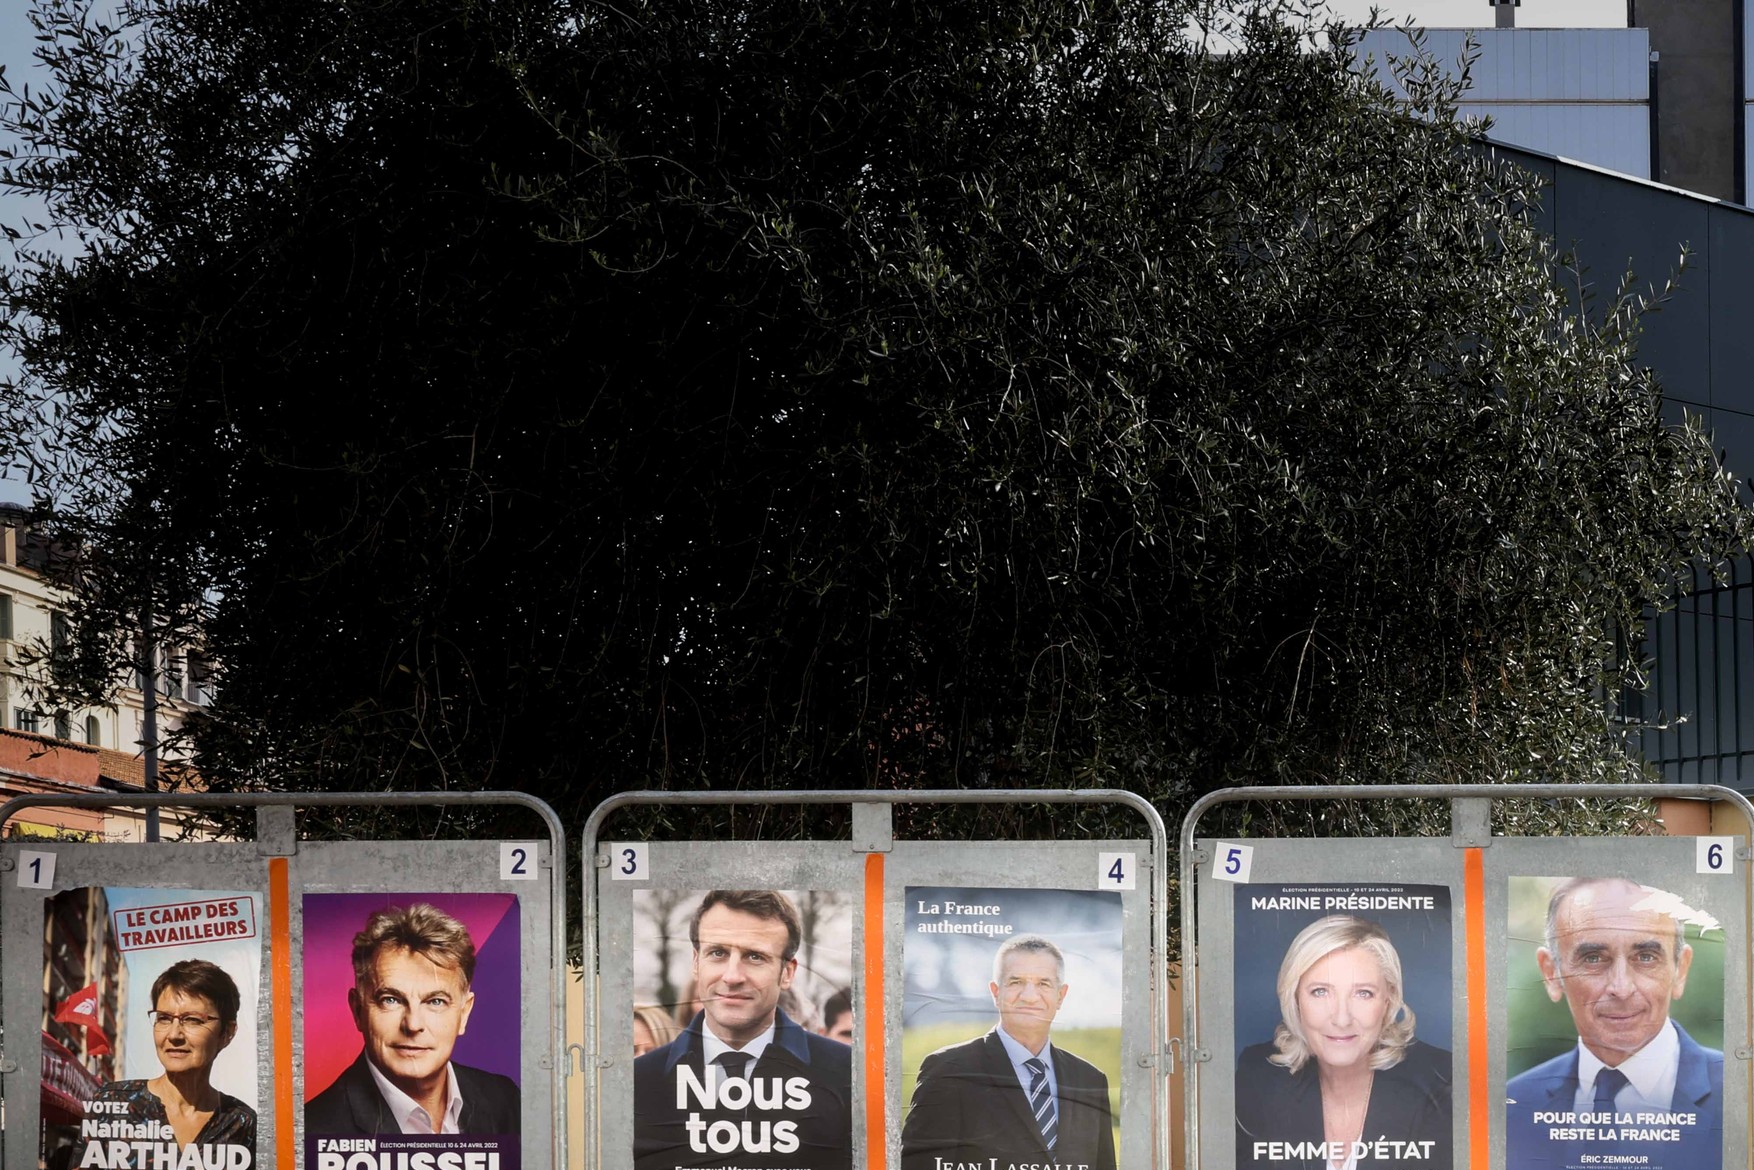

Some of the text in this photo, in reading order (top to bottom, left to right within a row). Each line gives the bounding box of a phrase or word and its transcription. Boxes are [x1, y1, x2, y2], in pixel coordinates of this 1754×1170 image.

[510, 849, 527, 875] 2
[621, 848, 637, 875] 3
[1225, 848, 1242, 875] 5
[1707, 843, 1723, 869] 6
[29, 857, 41, 883] 1
[1108, 858, 1124, 883] 4
[918, 901, 1001, 916] La France
[1251, 893, 1434, 910] MARINE PRÉSIDENTE
[126, 901, 238, 927] LE CAMP DES
[121, 920, 247, 947] TRAVAILLEURS
[917, 920, 1013, 937] authentique
[676, 1064, 812, 1110] Nous
[82, 1101, 129, 1114] VOTEZ
[1533, 1111, 1697, 1126] POUR QUE LA FRANCE
[82, 1119, 174, 1140] Nathalie
[685, 1112, 800, 1154] tous
[1549, 1128, 1680, 1141] RESTE LA FRANCE
[317, 1139, 376, 1152] FABIEN
[1253, 1141, 1345, 1160] FEMME
[1581, 1154, 1649, 1164] ÉRIC ZEMMOUR
